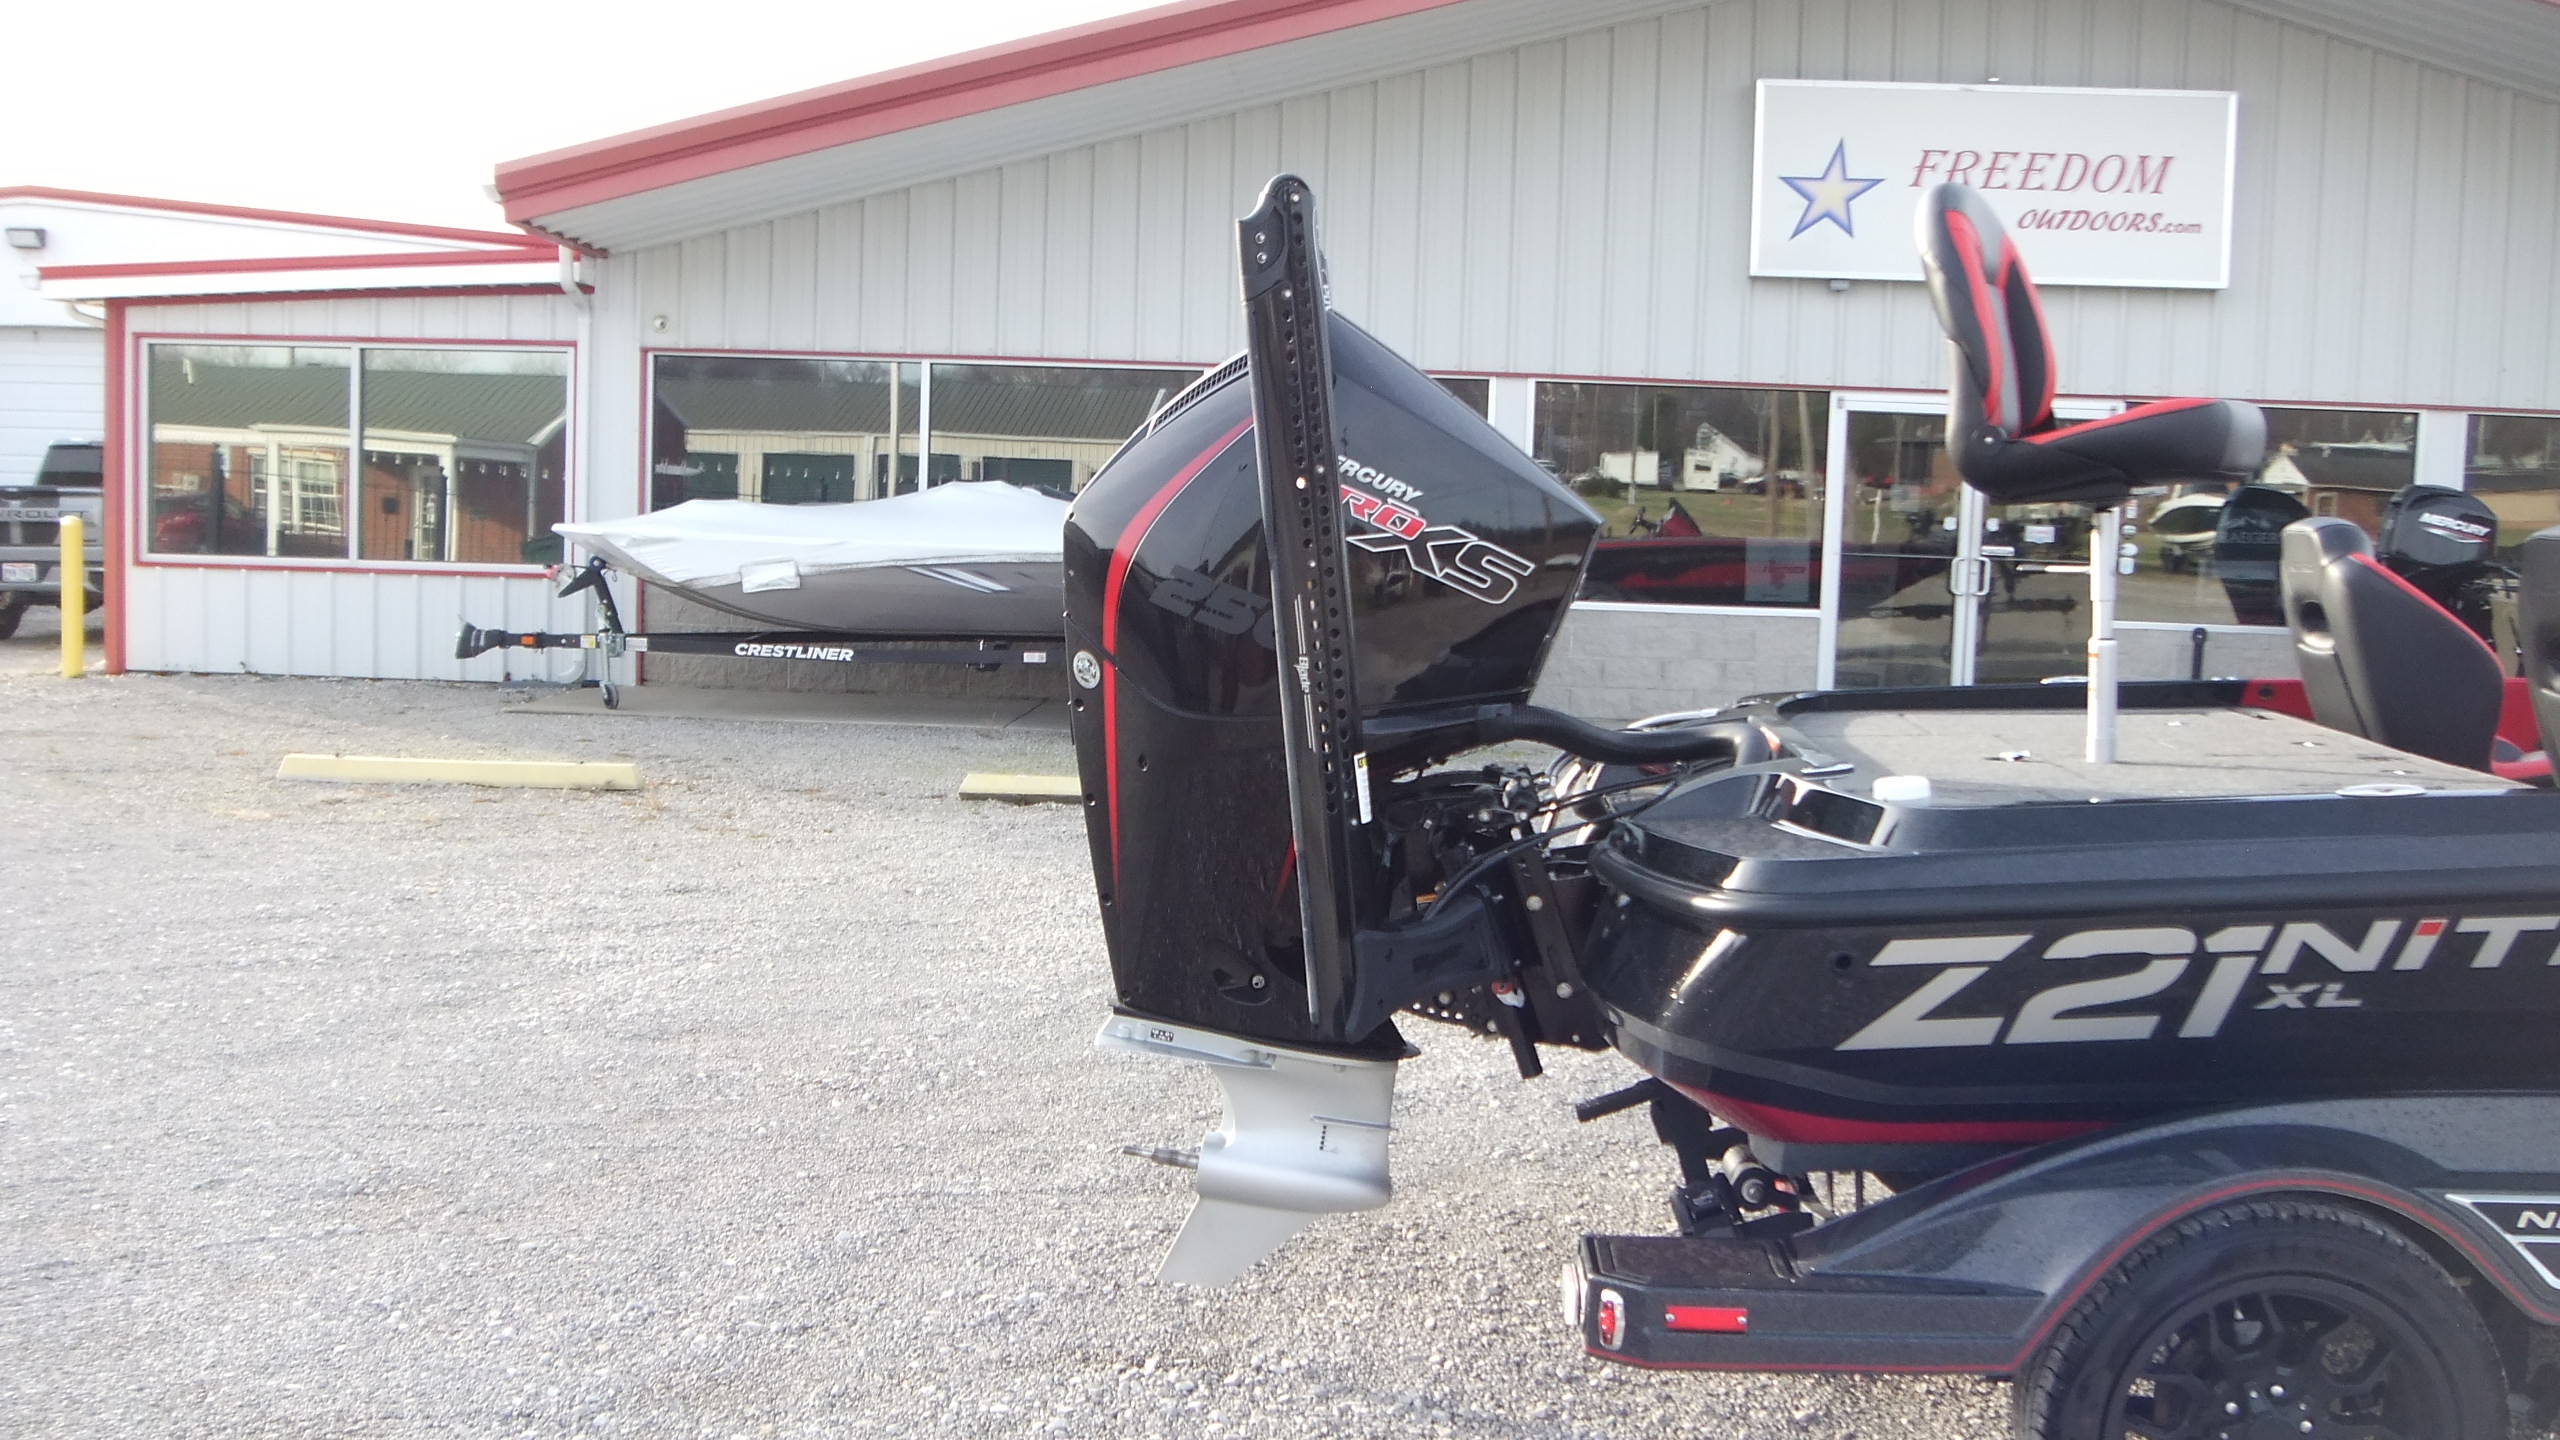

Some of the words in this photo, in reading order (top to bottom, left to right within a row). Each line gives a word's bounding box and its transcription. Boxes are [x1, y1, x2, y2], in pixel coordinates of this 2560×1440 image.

[1908, 149, 2174, 195] FREEDOM
[2017, 208, 2202, 234] OUTDOORS.com
[2418, 512, 2491, 537] MERCURY
[1346, 526, 1535, 604] XS
[734, 643, 854, 662] CRESTLINER
[1834, 926, 2274, 1052] Z21
[2254, 982, 2362, 1011] XL
